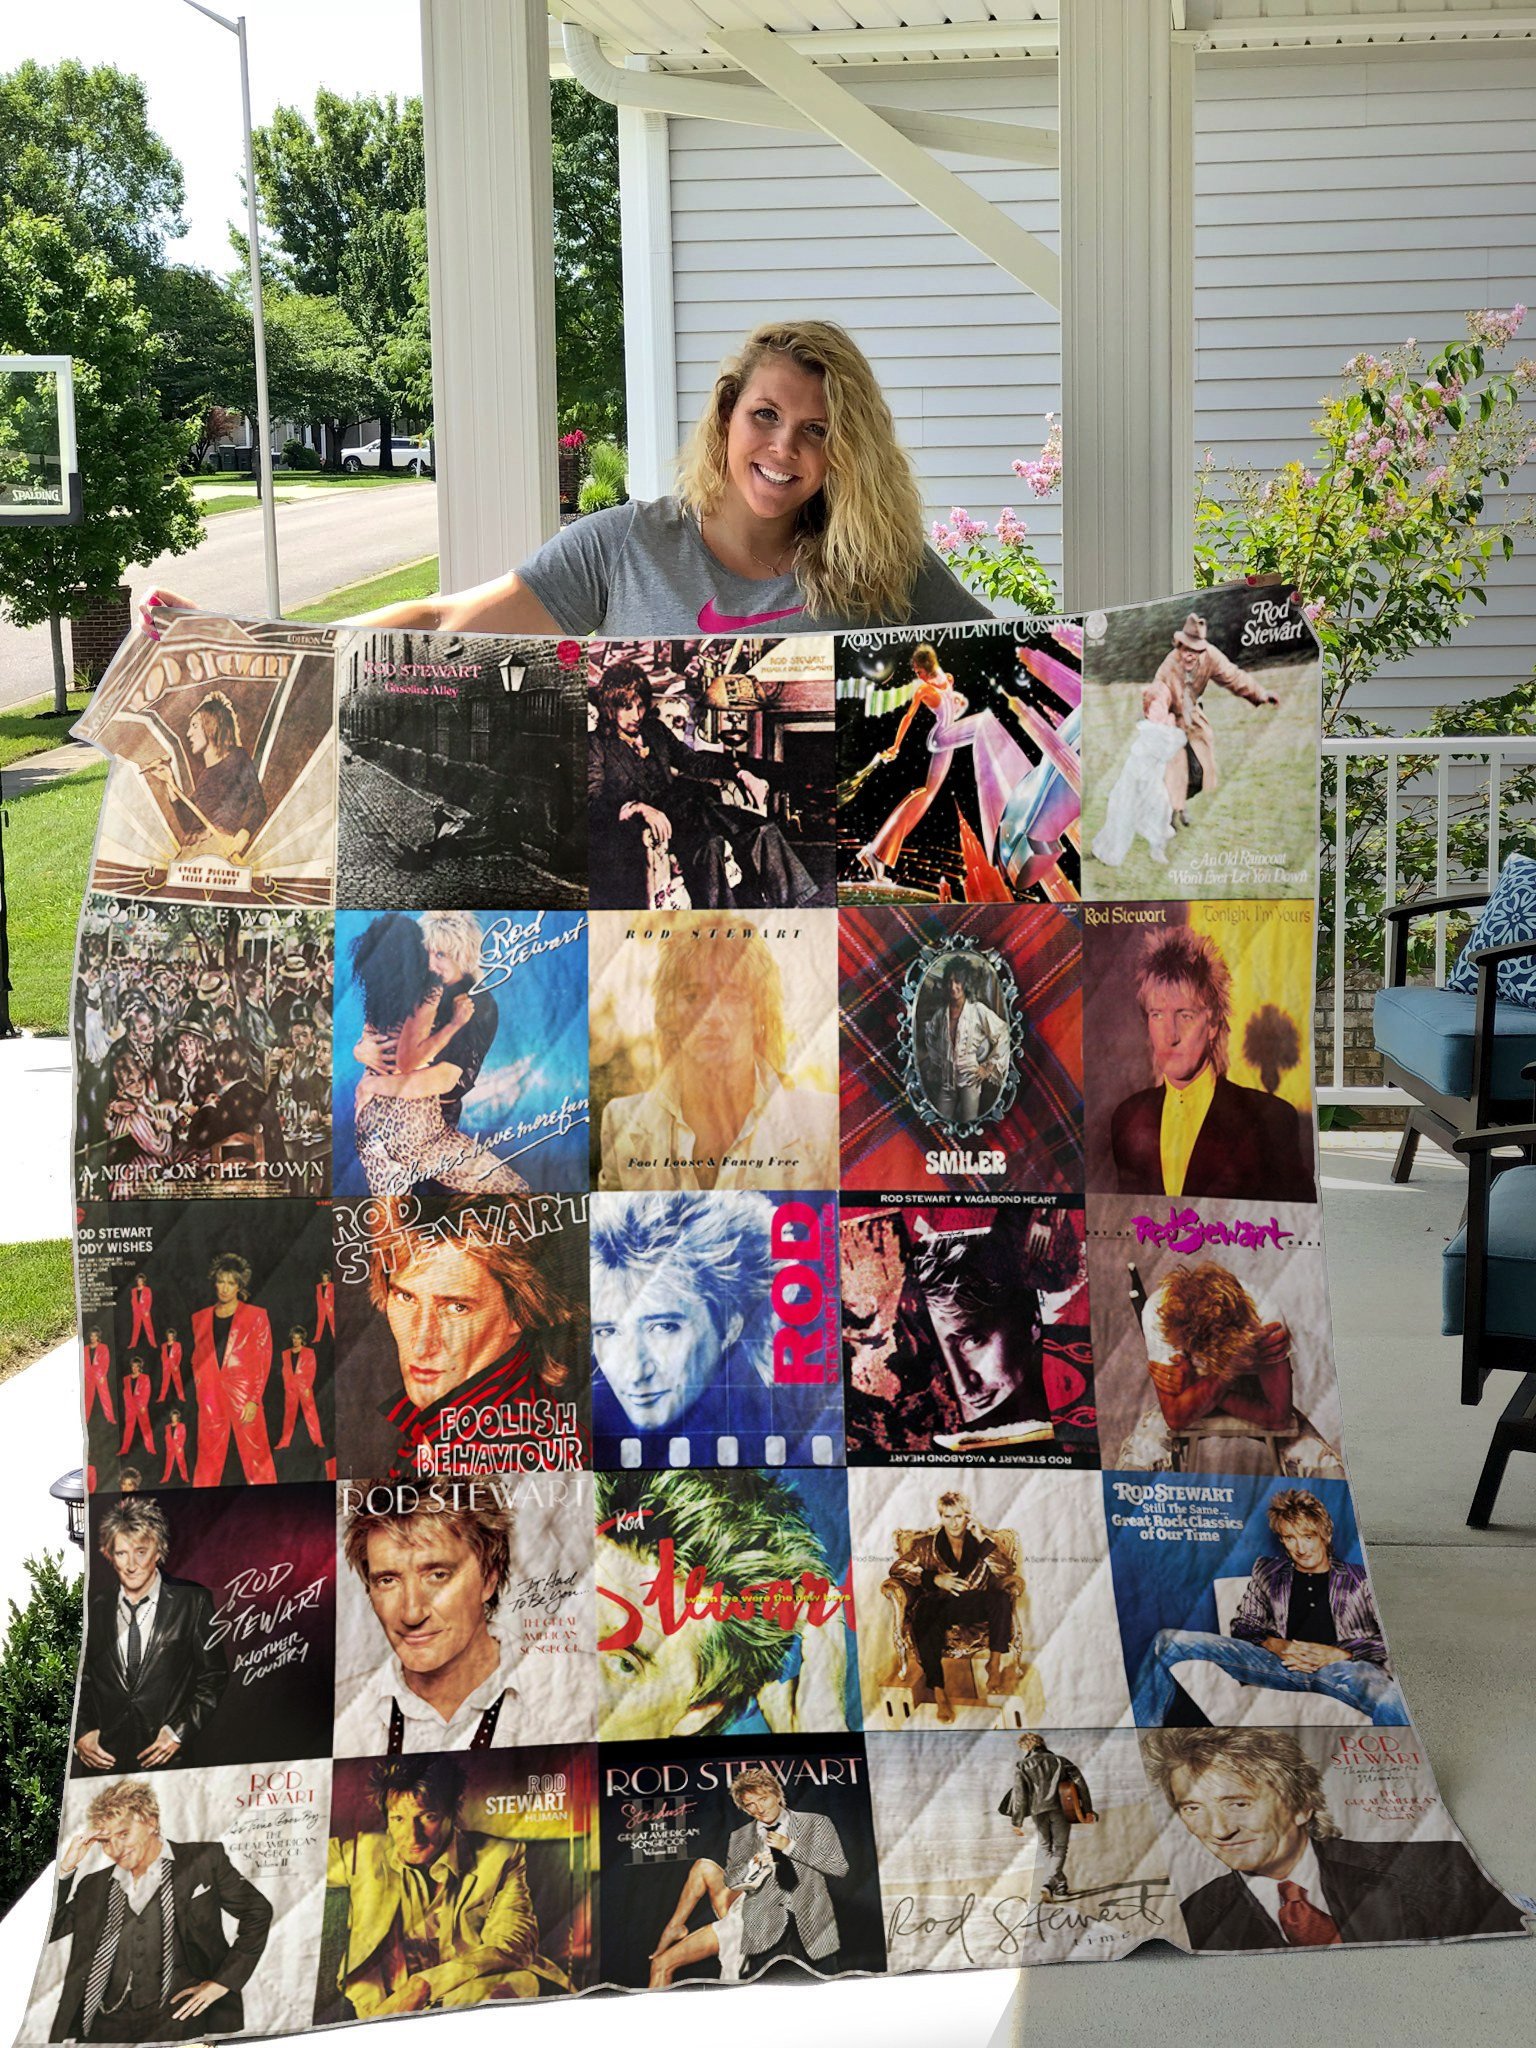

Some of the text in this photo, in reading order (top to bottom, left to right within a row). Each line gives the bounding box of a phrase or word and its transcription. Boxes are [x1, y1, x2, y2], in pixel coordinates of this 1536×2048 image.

[12, 489, 61, 502] SPALDING
[1251, 598, 1291, 626] Rod
[287, 635, 321, 645] EDITION
[841, 634, 871, 652] ROD
[870, 630, 937, 650] STEWART
[1241, 619, 1303, 647] Stewart
[364, 660, 481, 679] ROD STEWART
[384, 681, 459, 698] Gasoline Alley
[167, 905, 327, 926] STEWART
[1084, 907, 1167, 924] Rod Stewart
[624, 929, 803, 939] ROD STEWART
[466, 910, 591, 996] Rod Stewart
[470, 1131, 516, 1160] have
[517, 1111, 559, 1138] more
[101, 1163, 161, 1182] NIGHT
[169, 1163, 198, 1179] ON
[207, 1162, 248, 1178] THE
[254, 1161, 325, 1178] TOWN
[722, 1157, 763, 1169] Fancy
[768, 1157, 800, 1167] Free
[925, 1150, 1007, 1175] SMILER
[880, 1194, 904, 1203] ROD
[905, 1195, 951, 1203] STEWART
[964, 1195, 1022, 1204] VAGABOND
[332, 1196, 421, 1246] ROD
[79, 1227, 153, 1240] OD STEWART
[336, 1194, 590, 1284] STEWART
[80, 1242, 153, 1255] ODY WISHES
[771, 1202, 824, 1384] ROD
[824, 1293, 839, 1384] STEWART
[440, 1399, 577, 1441] FOOLISH
[417, 1437, 583, 1477] BEHAVIOUR
[889, 1455, 1072, 1464] ROD STEWART VAGABOND HEART
[342, 1479, 588, 1517] ROD STEWART
[1113, 1482, 1234, 1506] ROD STEWART
[616, 1505, 645, 1532] Rod
[1142, 1504, 1166, 1514] Still
[1167, 1503, 1187, 1514] The
[1112, 1514, 1244, 1529] Great Rock Classics
[1140, 1527, 1220, 1541] of Our Time
[224, 1562, 294, 1612] ROD
[203, 1576, 328, 1651] STEWART
[232, 1631, 304, 1673] ANOTHER
[242, 1642, 309, 1686] COUNTRY
[1340, 1735, 1401, 1752] ROD
[251, 1771, 302, 1792] ROD
[527, 1773, 567, 1794] ROD
[606, 1765, 689, 1797] ROD
[485, 1792, 566, 1816] STEWART
[525, 1812, 568, 1822] HUMAN
[631, 1838, 688, 1850] SONGBOOK
[649, 1828, 701, 1840] AMERICAN
[887, 1885, 1177, 1964] Rod Stewart
